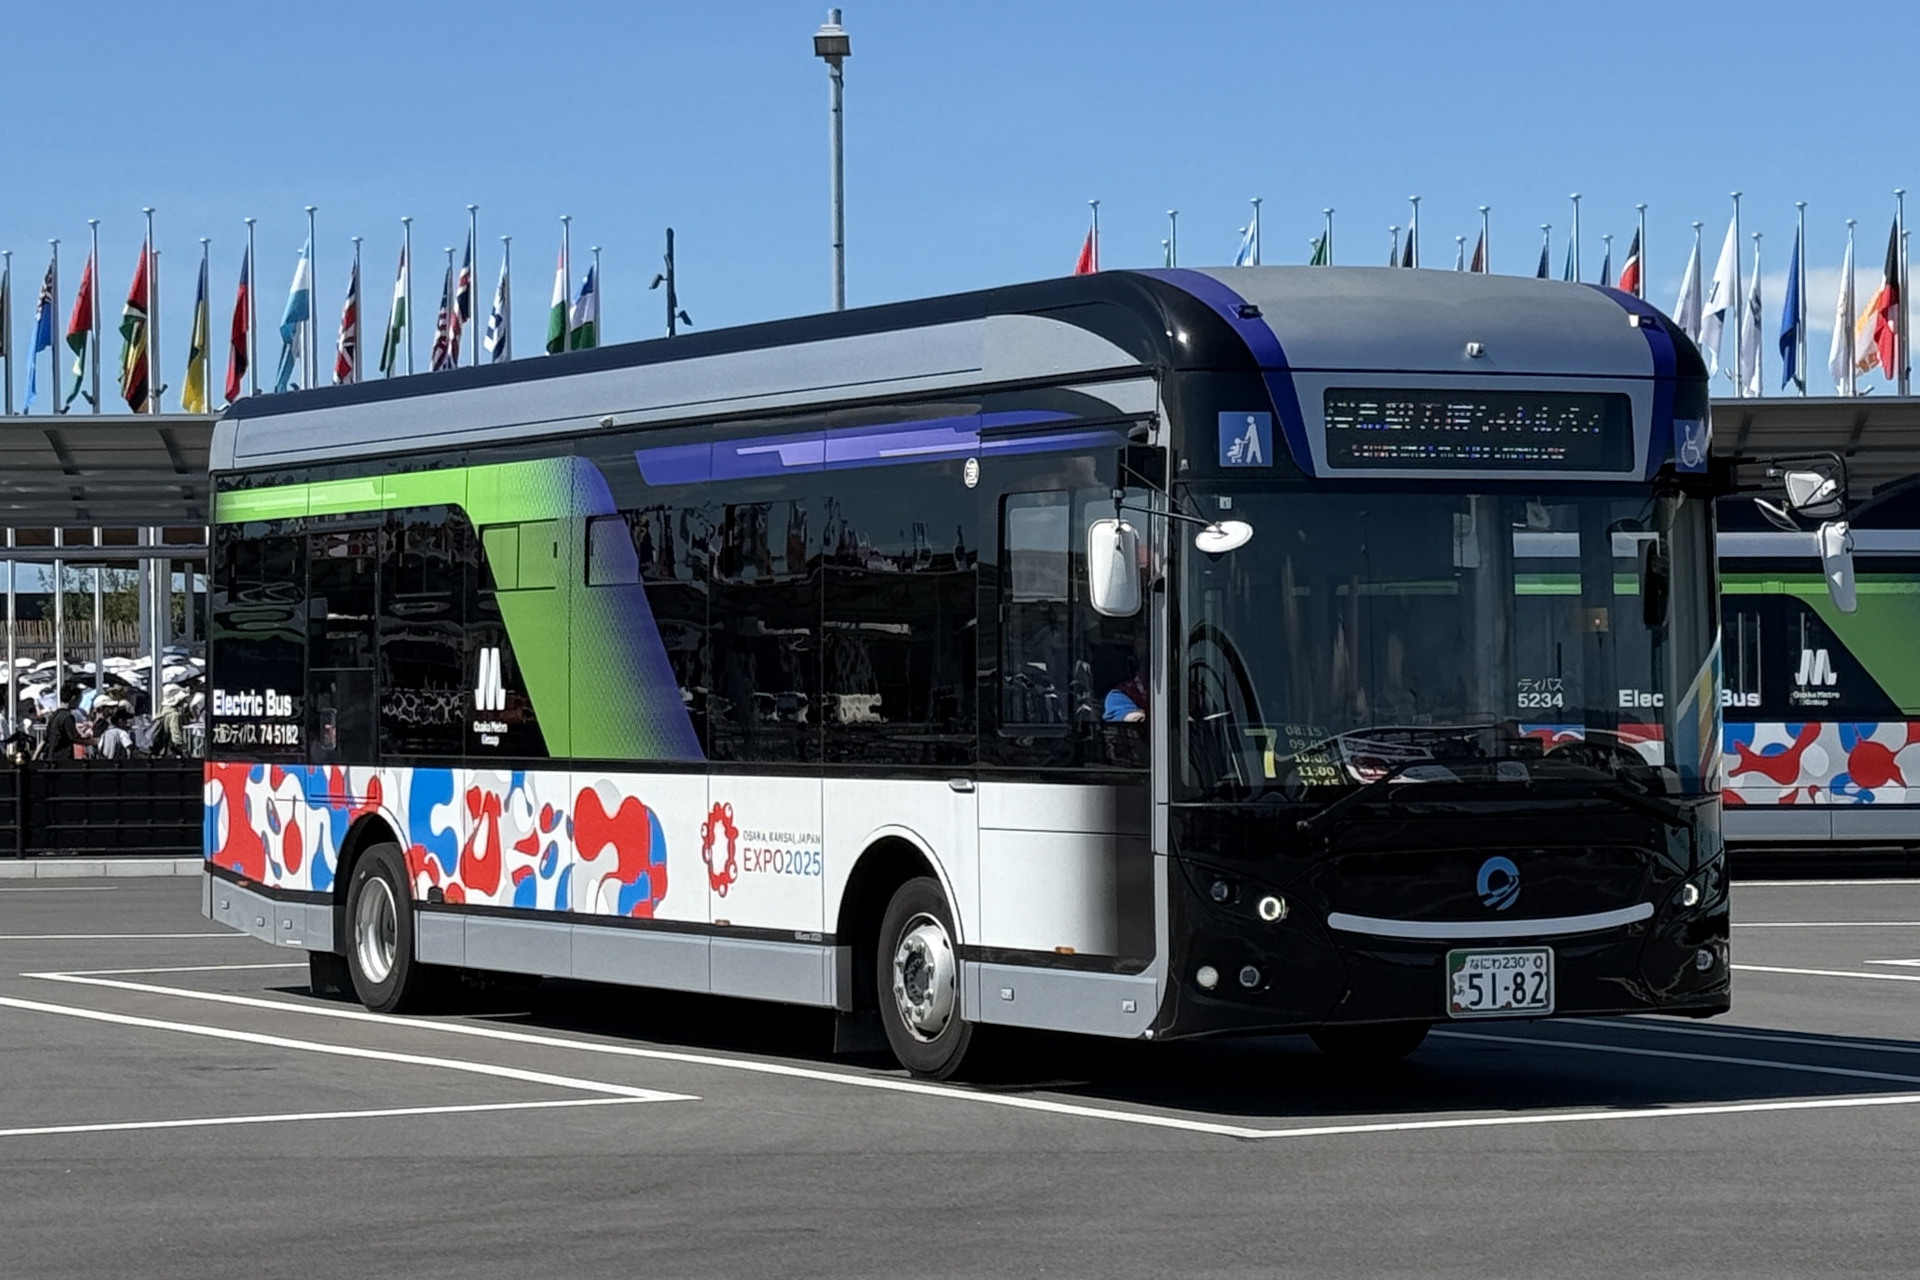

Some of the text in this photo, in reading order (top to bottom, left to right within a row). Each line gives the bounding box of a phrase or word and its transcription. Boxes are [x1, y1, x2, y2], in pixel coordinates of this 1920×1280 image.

[1517, 678, 1564, 692] ティバス
[213, 688, 292, 716] Electric Bus
[1517, 692, 1564, 708] 5234
[1297, 765, 1335, 777] 11:00
[743, 847, 821, 877] EXPO2025
[1468, 971, 1545, 1007] 51-82
